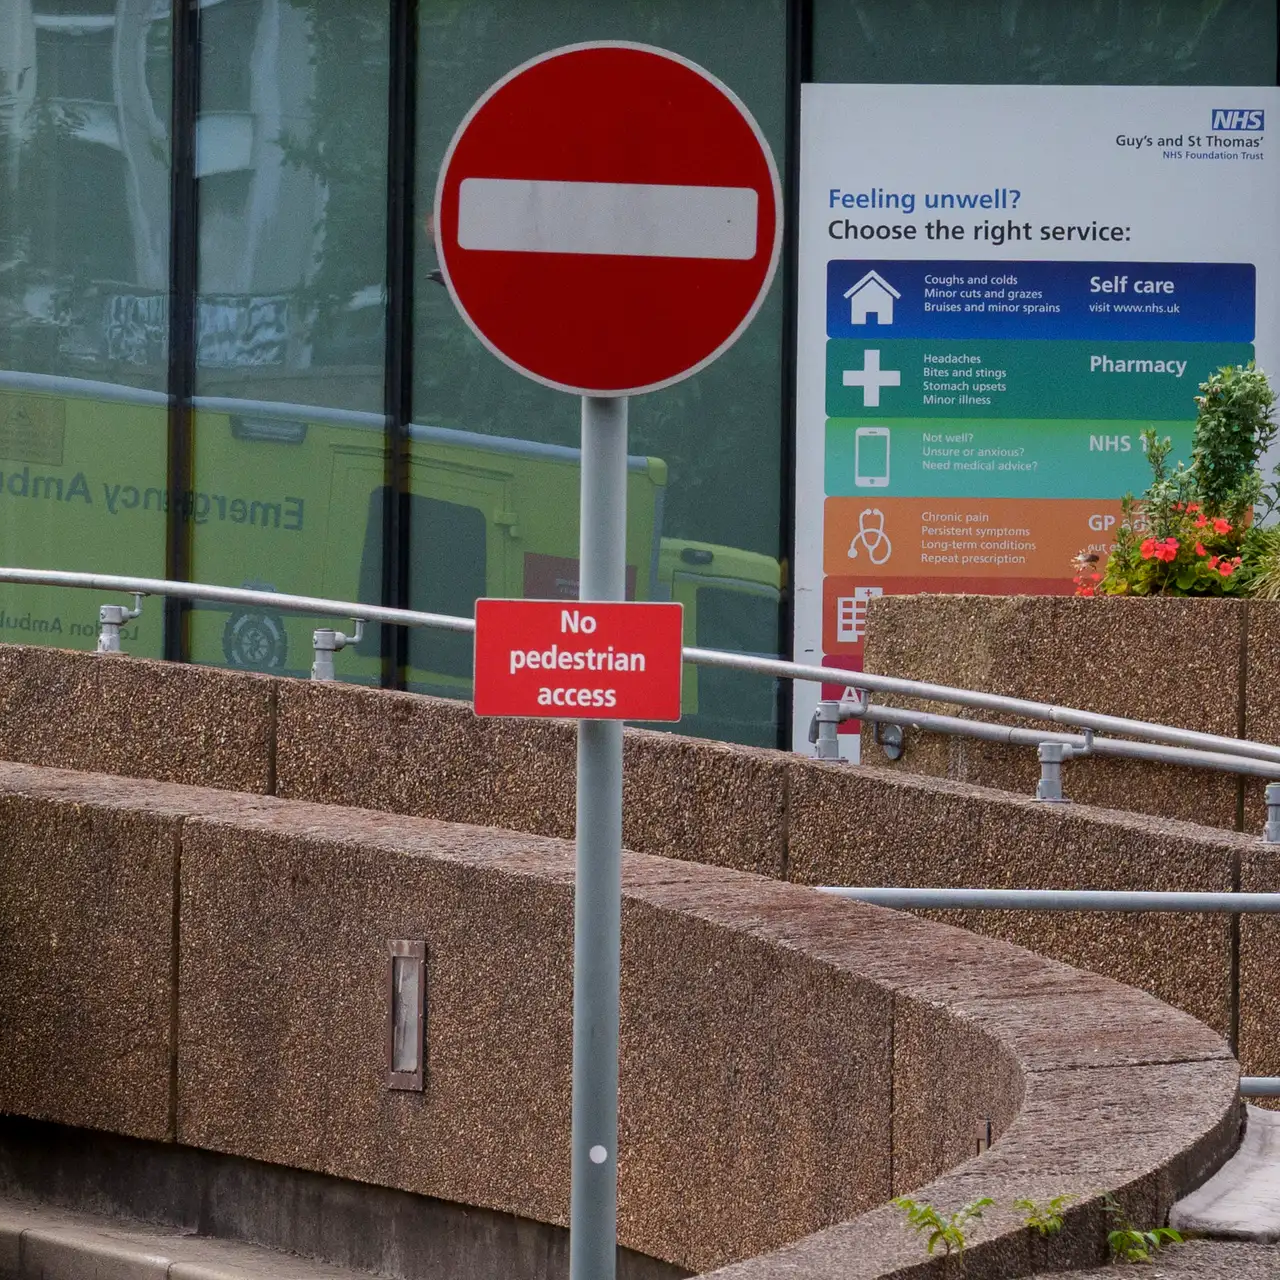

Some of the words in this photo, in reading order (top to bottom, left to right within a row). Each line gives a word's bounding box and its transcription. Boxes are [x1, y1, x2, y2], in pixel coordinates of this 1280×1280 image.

[1212, 109, 1264, 130] NHS
[1116, 135, 1153, 149] Guy's
[1158, 135, 1183, 147] and
[1188, 135, 1202, 148] St
[1163, 151, 1183, 160] NHS
[1186, 151, 1238, 161] Foundation
[1241, 151, 1264, 160] Trust
[829, 188, 915, 214] Feeling
[925, 189, 1021, 209] unwell?
[829, 220, 917, 241] Choose
[925, 220, 965, 241] the
[973, 221, 1032, 246] right
[1040, 221, 1131, 242] service:
[924, 275, 965, 287] Coughs
[966, 275, 988, 285] and
[992, 275, 1018, 285] colds
[1090, 276, 1128, 293] Self
[1133, 280, 1174, 294] care
[924, 288, 957, 299] Minor
[959, 289, 981, 299] cuts
[984, 288, 1005, 299] and
[1007, 291, 1043, 302] grazes
[924, 302, 961, 313] Bruises
[965, 302, 985, 313] and
[988, 302, 1021, 313] minor
[1023, 303, 1061, 316] sprains
[1089, 303, 1110, 313] visit
[1114, 303, 1180, 314] www.nhs.uk
[924, 354, 981, 364] Headaches
[1090, 355, 1187, 378] Pharmacy
[924, 368, 949, 378] Bites
[952, 368, 972, 378] and
[975, 368, 1007, 381] stings
[924, 381, 969, 392] Stomach
[972, 382, 1007, 394] upsets
[924, 395, 955, 405] Minor
[958, 395, 991, 405] illness
[922, 433, 944, 443] Not
[945, 433, 974, 443] well?
[1089, 435, 1131, 452] NHS
[922, 447, 961, 457] Unsure
[964, 449, 975, 457] or
[979, 447, 1025, 458] anxious?
[922, 461, 950, 471] Need
[953, 461, 996, 472] medical
[999, 462, 1038, 472] advice?
[921, 512, 963, 523] Chronic
[966, 512, 989, 525] pain
[1088, 515, 1115, 531] GP
[921, 526, 972, 537] Persistent
[976, 527, 1030, 539] symptoms
[921, 540, 980, 553] Long-term
[981, 540, 1037, 551] conditions
[921, 554, 958, 566] Repeat
[961, 554, 1026, 567] prescription
[560, 610, 596, 634] No
[510, 644, 646, 675] pedestrian
[538, 687, 617, 707] access
